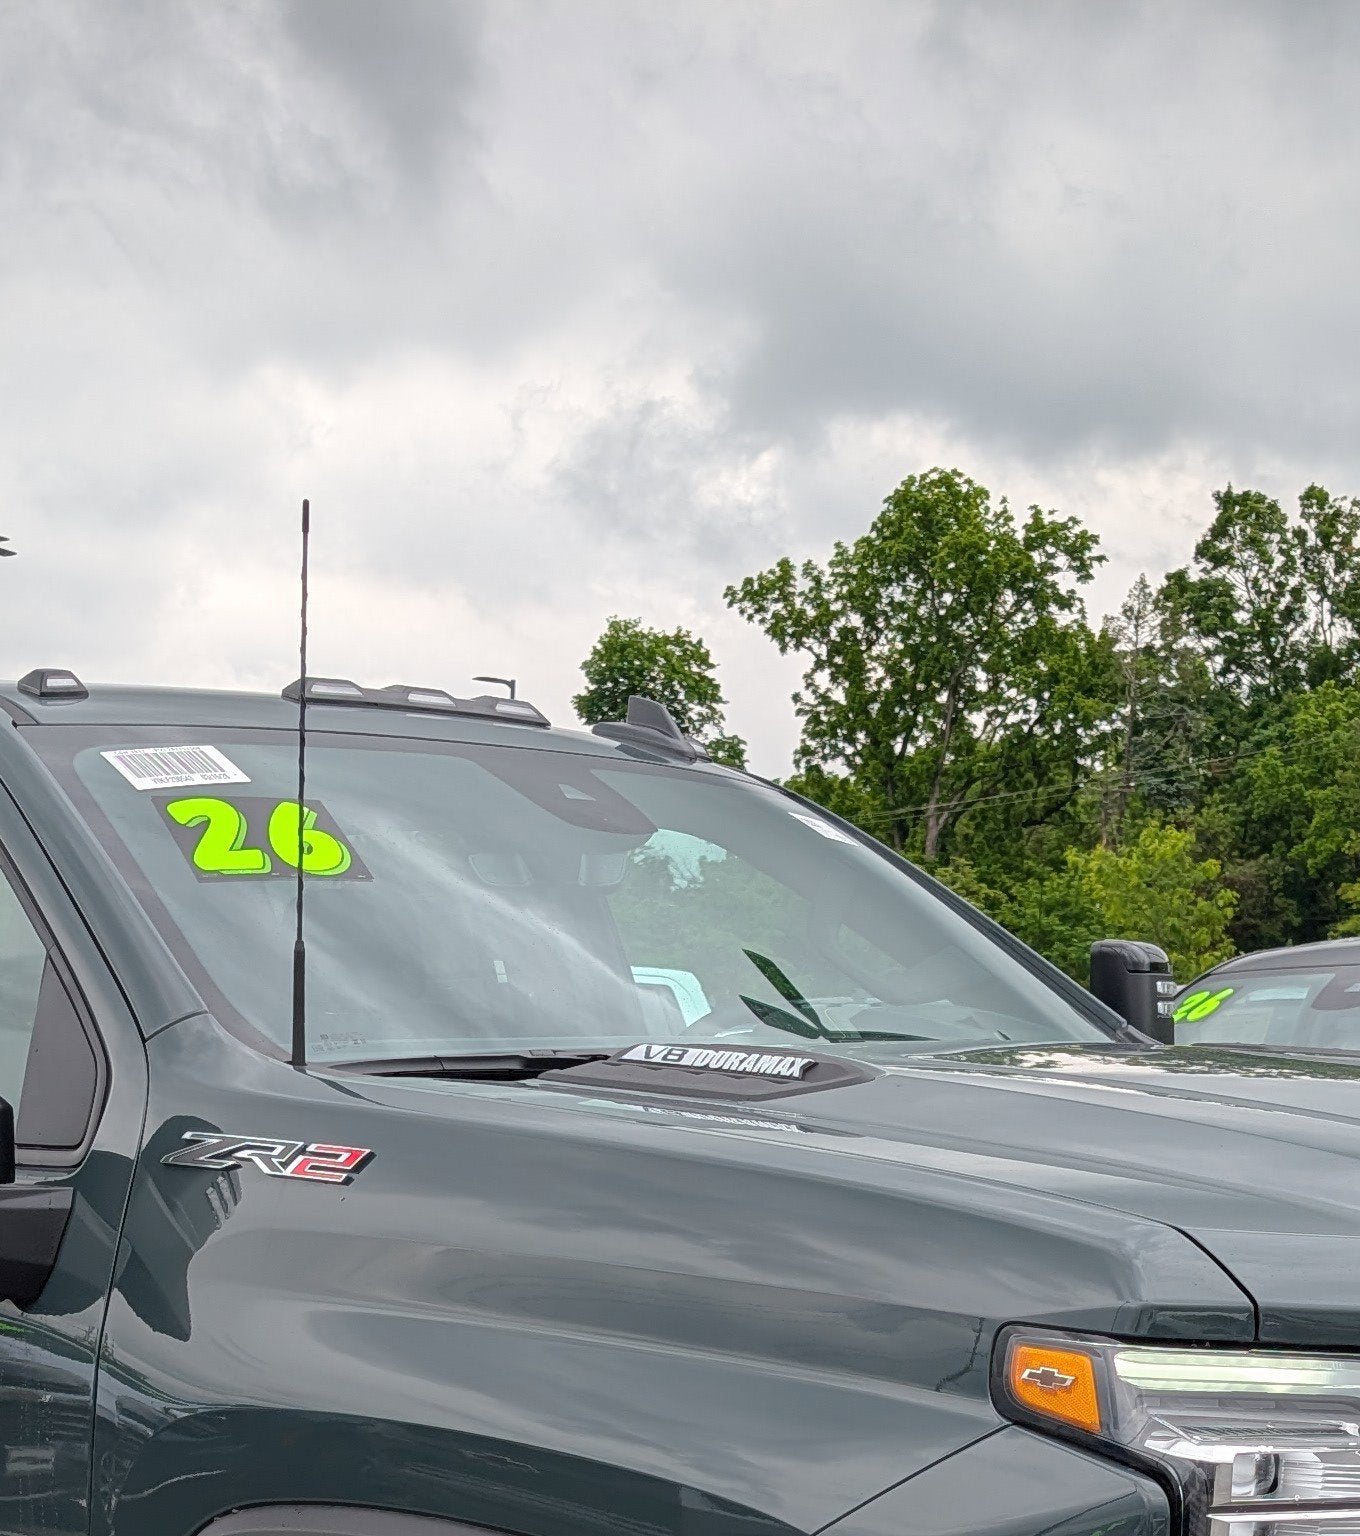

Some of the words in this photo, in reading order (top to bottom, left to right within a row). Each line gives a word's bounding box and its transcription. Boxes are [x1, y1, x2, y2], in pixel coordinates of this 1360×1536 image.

[166, 796, 352, 876] 26
[644, 1045, 691, 1063] V8
[692, 1048, 816, 1079] DURAMAX
[160, 1131, 378, 1186] ZR2
